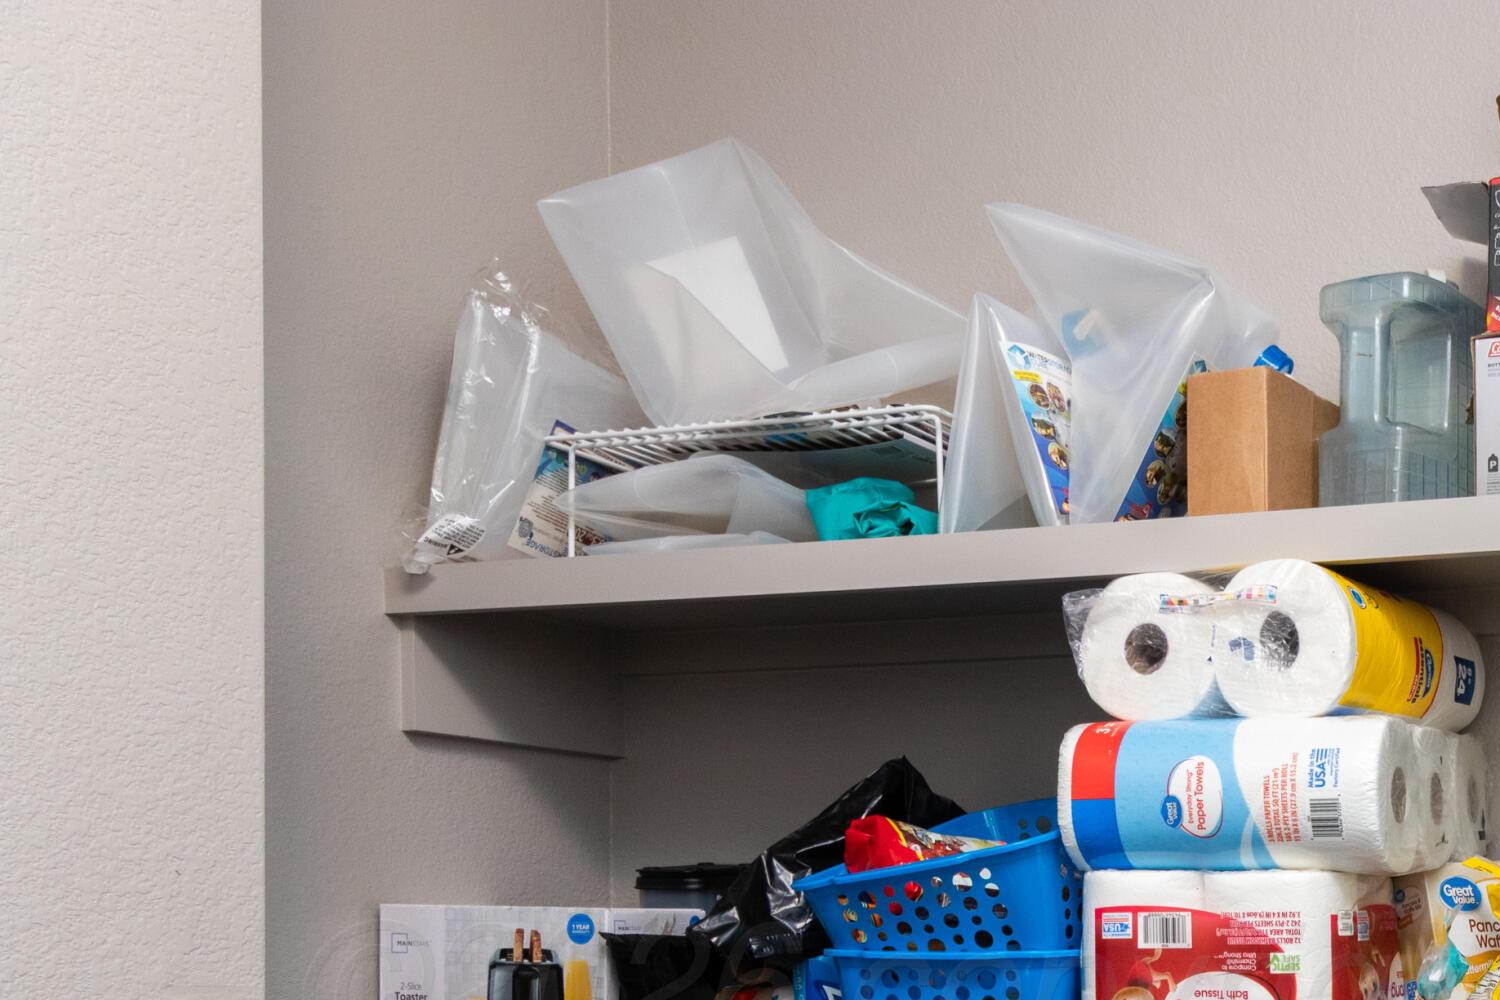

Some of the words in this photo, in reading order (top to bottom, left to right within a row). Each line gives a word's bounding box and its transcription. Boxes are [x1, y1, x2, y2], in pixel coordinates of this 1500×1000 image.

[1194, 761, 1204, 796] Towels
[1307, 768, 1315, 788] Made
[1315, 762, 1326, 787] USA
[1166, 802, 1174, 824] Great
[1196, 799, 1206, 830] Paper
[1443, 884, 1474, 897] Great
[1453, 895, 1476, 904] Value
[1103, 922, 1121, 932] USA
[1269, 928, 1283, 936] AREA
[1284, 928, 1301, 936] TOTAL
[1280, 953, 1301, 963] SAFE
[1232, 963, 1257, 971] Compare
[1272, 962, 1301, 972] SEPTIC
[400, 982, 422, 990] 2-Slice
[1193, 989, 1224, 999] Tissue
[1226, 989, 1248, 999] Bath
